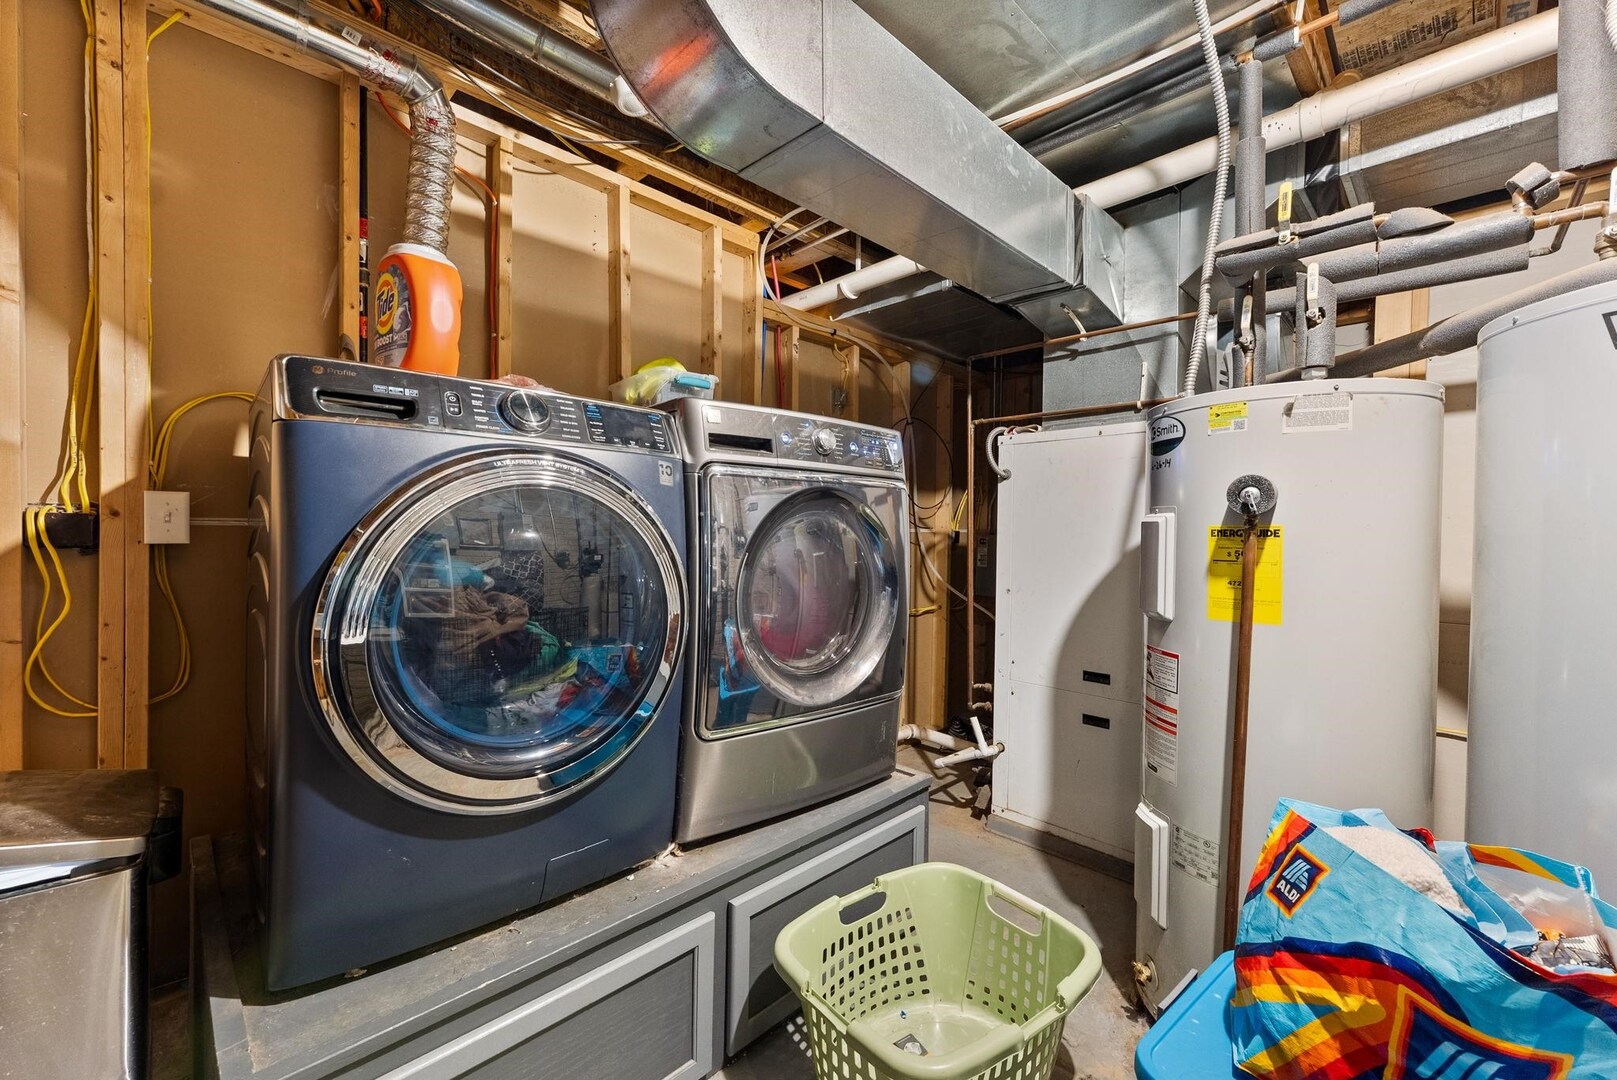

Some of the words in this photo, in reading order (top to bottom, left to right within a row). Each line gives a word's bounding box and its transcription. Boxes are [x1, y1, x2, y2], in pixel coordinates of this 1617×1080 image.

[377, 285, 395, 318] Tide
[327, 367, 357, 377] Profile
[537, 460, 555, 468] VENT
[1276, 879, 1301, 903] ALDI
